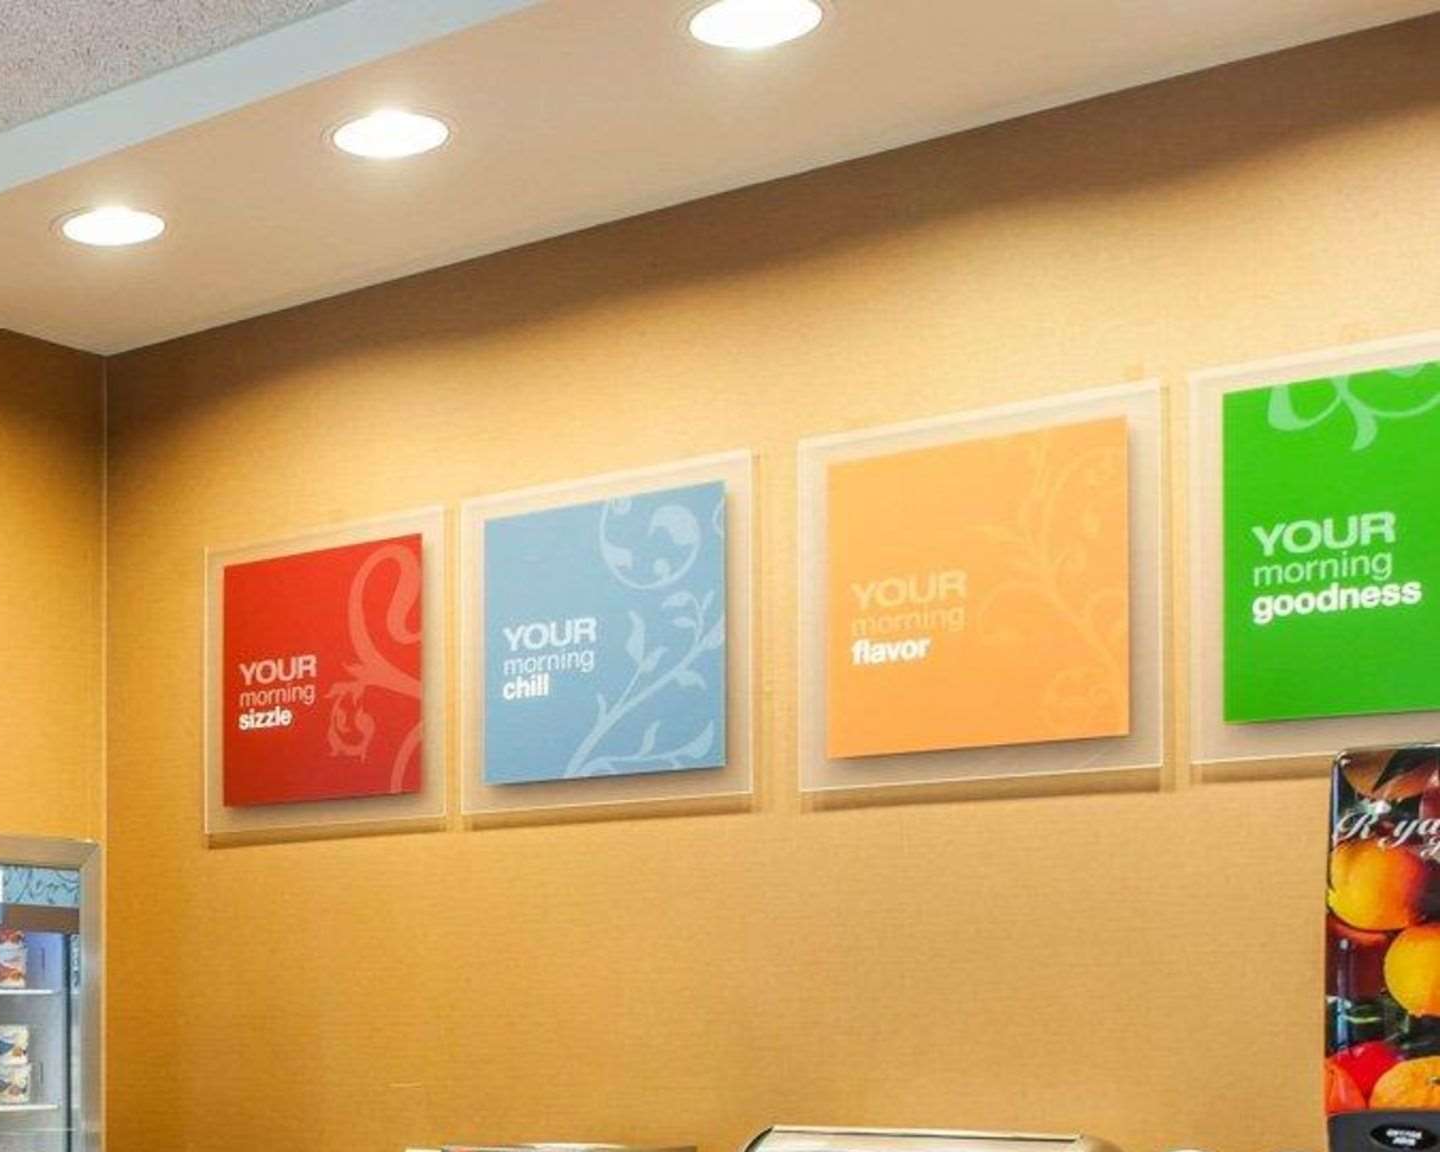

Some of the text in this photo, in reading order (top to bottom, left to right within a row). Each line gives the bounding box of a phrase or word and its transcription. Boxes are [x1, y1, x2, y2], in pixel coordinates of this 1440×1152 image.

[1251, 511, 1396, 556] YOUR
[1253, 551, 1392, 587] morning
[851, 570, 968, 609] YOUR
[1252, 582, 1422, 625] goodness
[502, 617, 597, 651] YOUR
[851, 605, 965, 637] morning
[503, 649, 595, 676] morning
[851, 638, 931, 665] flavor
[238, 654, 317, 686] YOUR
[239, 683, 316, 708] morning
[503, 672, 549, 701] chill
[238, 706, 293, 731] sizzle
